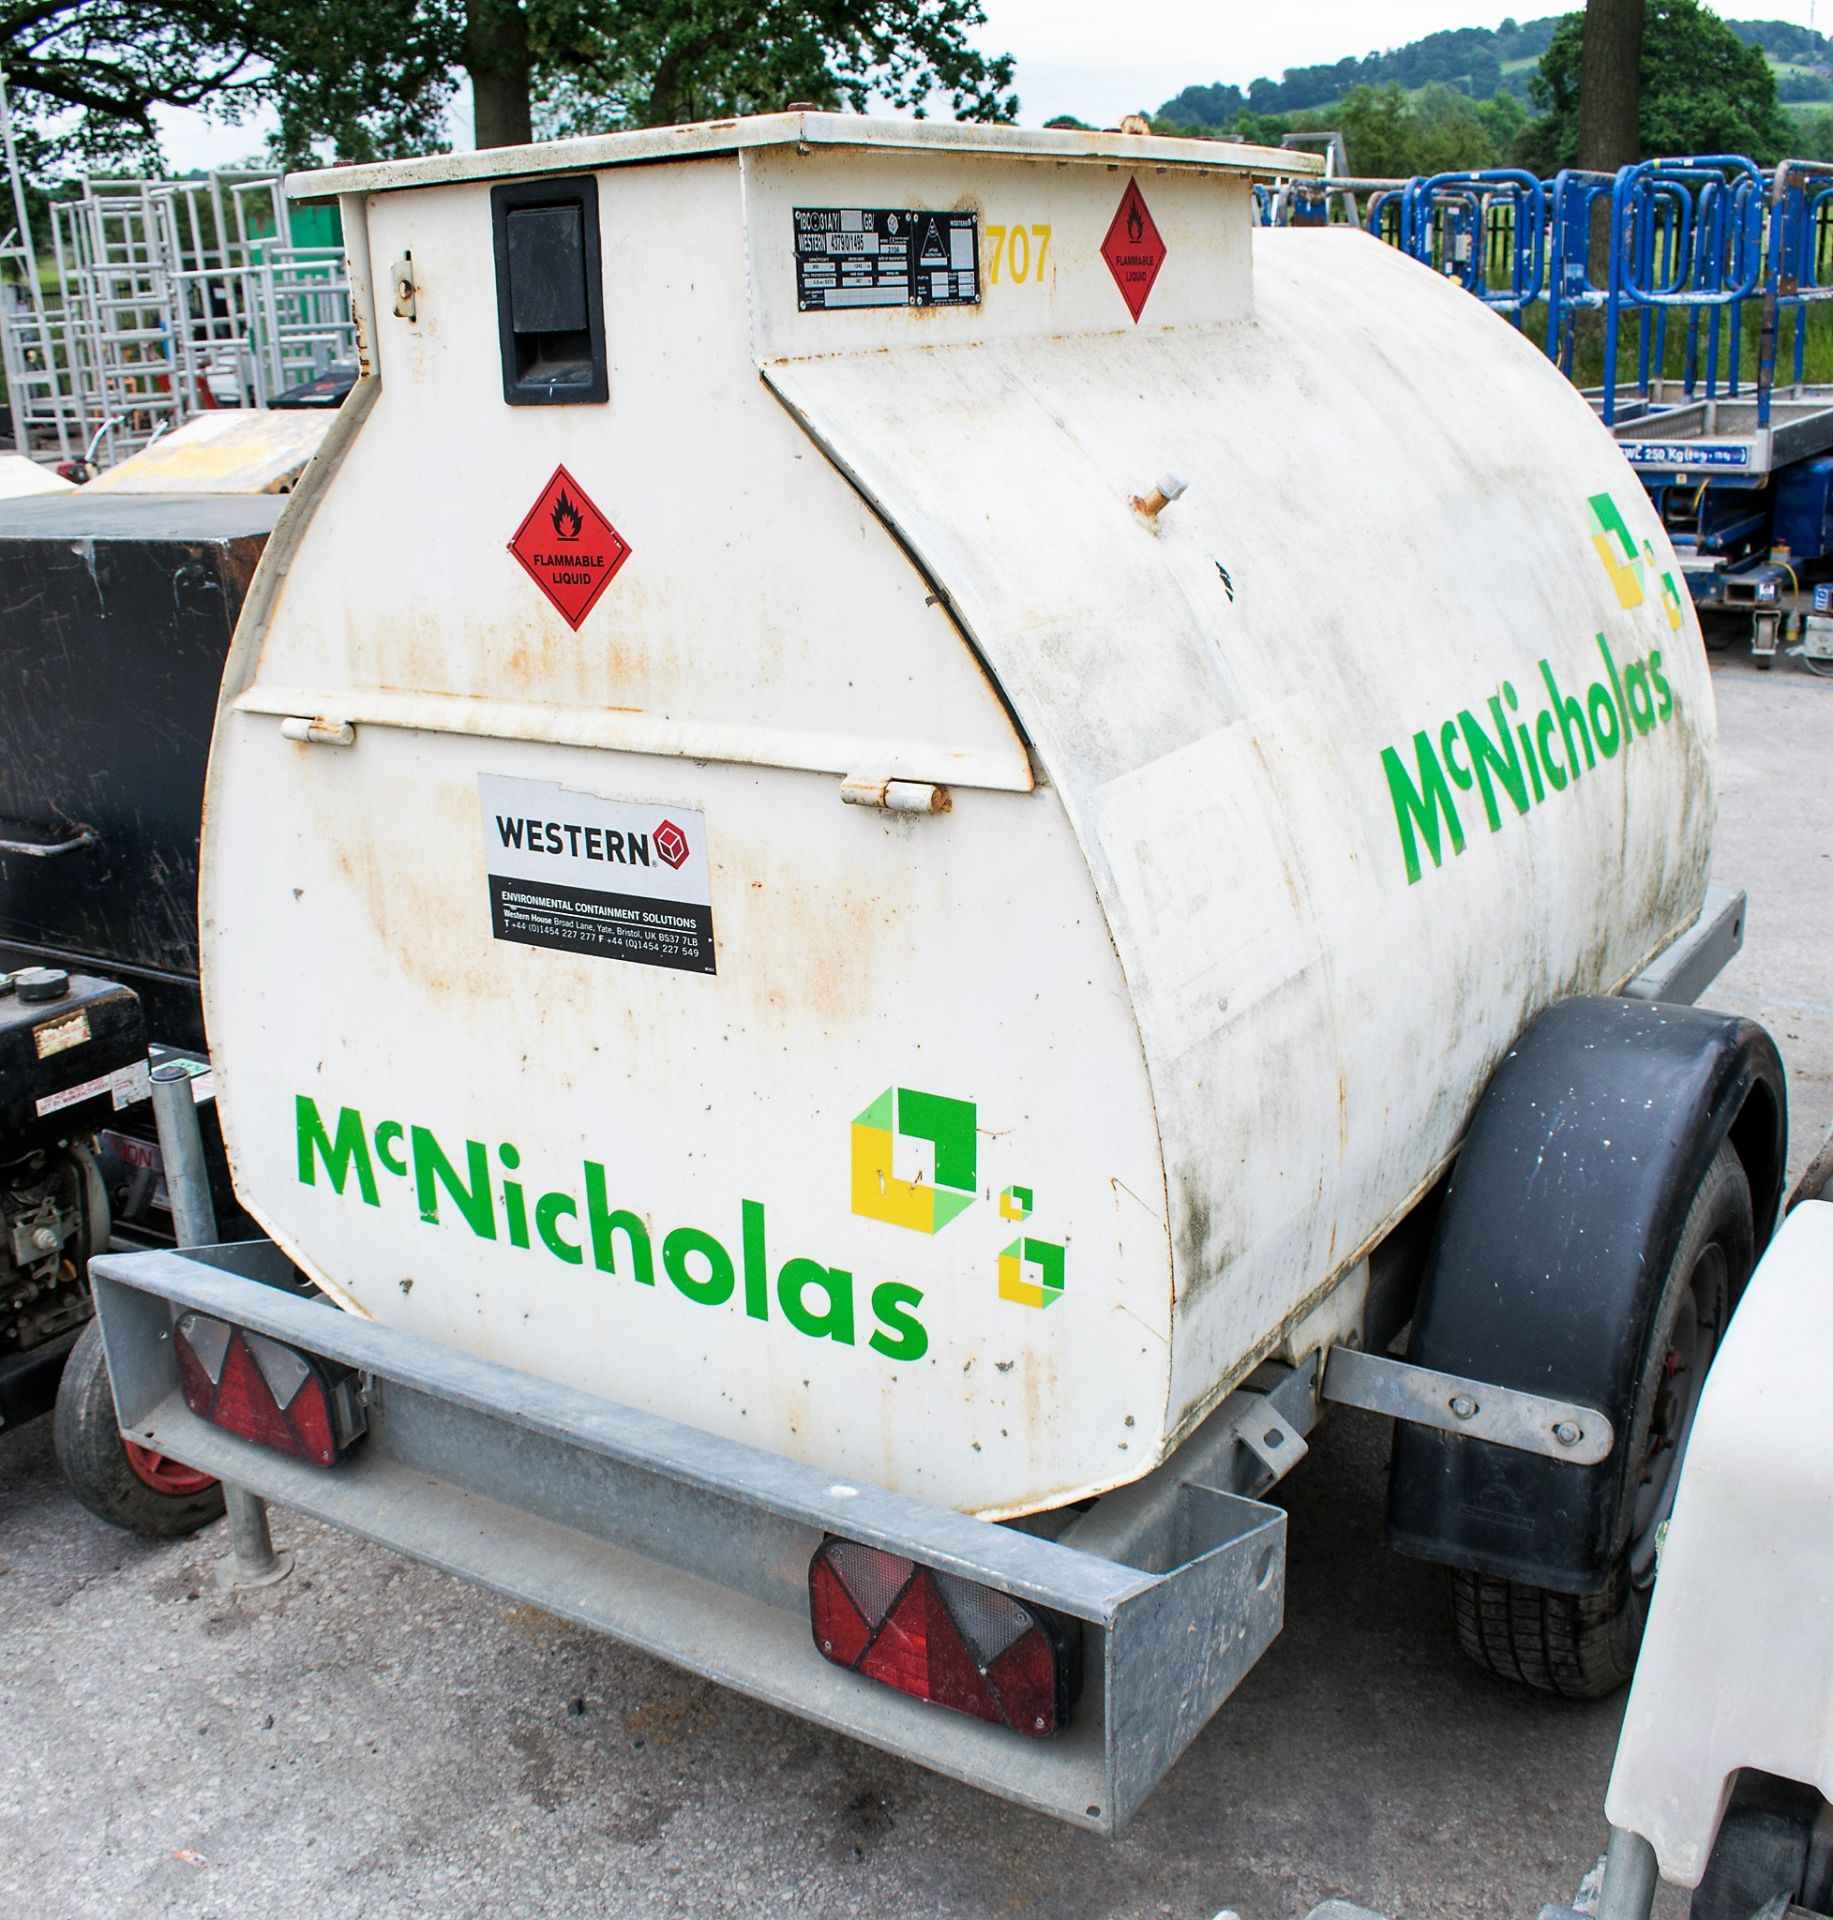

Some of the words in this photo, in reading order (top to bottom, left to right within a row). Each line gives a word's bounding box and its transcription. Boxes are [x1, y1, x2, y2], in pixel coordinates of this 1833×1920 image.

[797, 234, 826, 252] WESTERN
[985, 224, 1052, 285] 707
[1116, 255, 1154, 266] FLAMMABLE
[1125, 271, 1147, 282] LIQUID
[1645, 448, 1666, 460] 250
[533, 554, 605, 568] FLAMMABLE
[552, 573, 592, 585] LIQUID
[1380, 631, 1673, 886] McNicholas
[495, 815, 650, 867] WESTERN
[501, 891, 573, 911] ENVIRONMENTAL
[575, 902, 640, 920] CONTAINMENT
[642, 912, 697, 929] SOLUTIONS
[503, 909, 530, 921] Western
[531, 913, 552, 925] House
[554, 917, 574, 928] Broad
[644, 931, 657, 941] UK
[659, 934, 680, 944] BS37
[683, 937, 699, 947] 7LB
[504, 919, 510, 927] T
[562, 929, 578, 938] 227
[580, 932, 596, 941] 277
[598, 935, 604, 943] F
[663, 945, 679, 954] 227
[682, 947, 700, 958] 549
[295, 1093, 929, 1362] McNicholas
